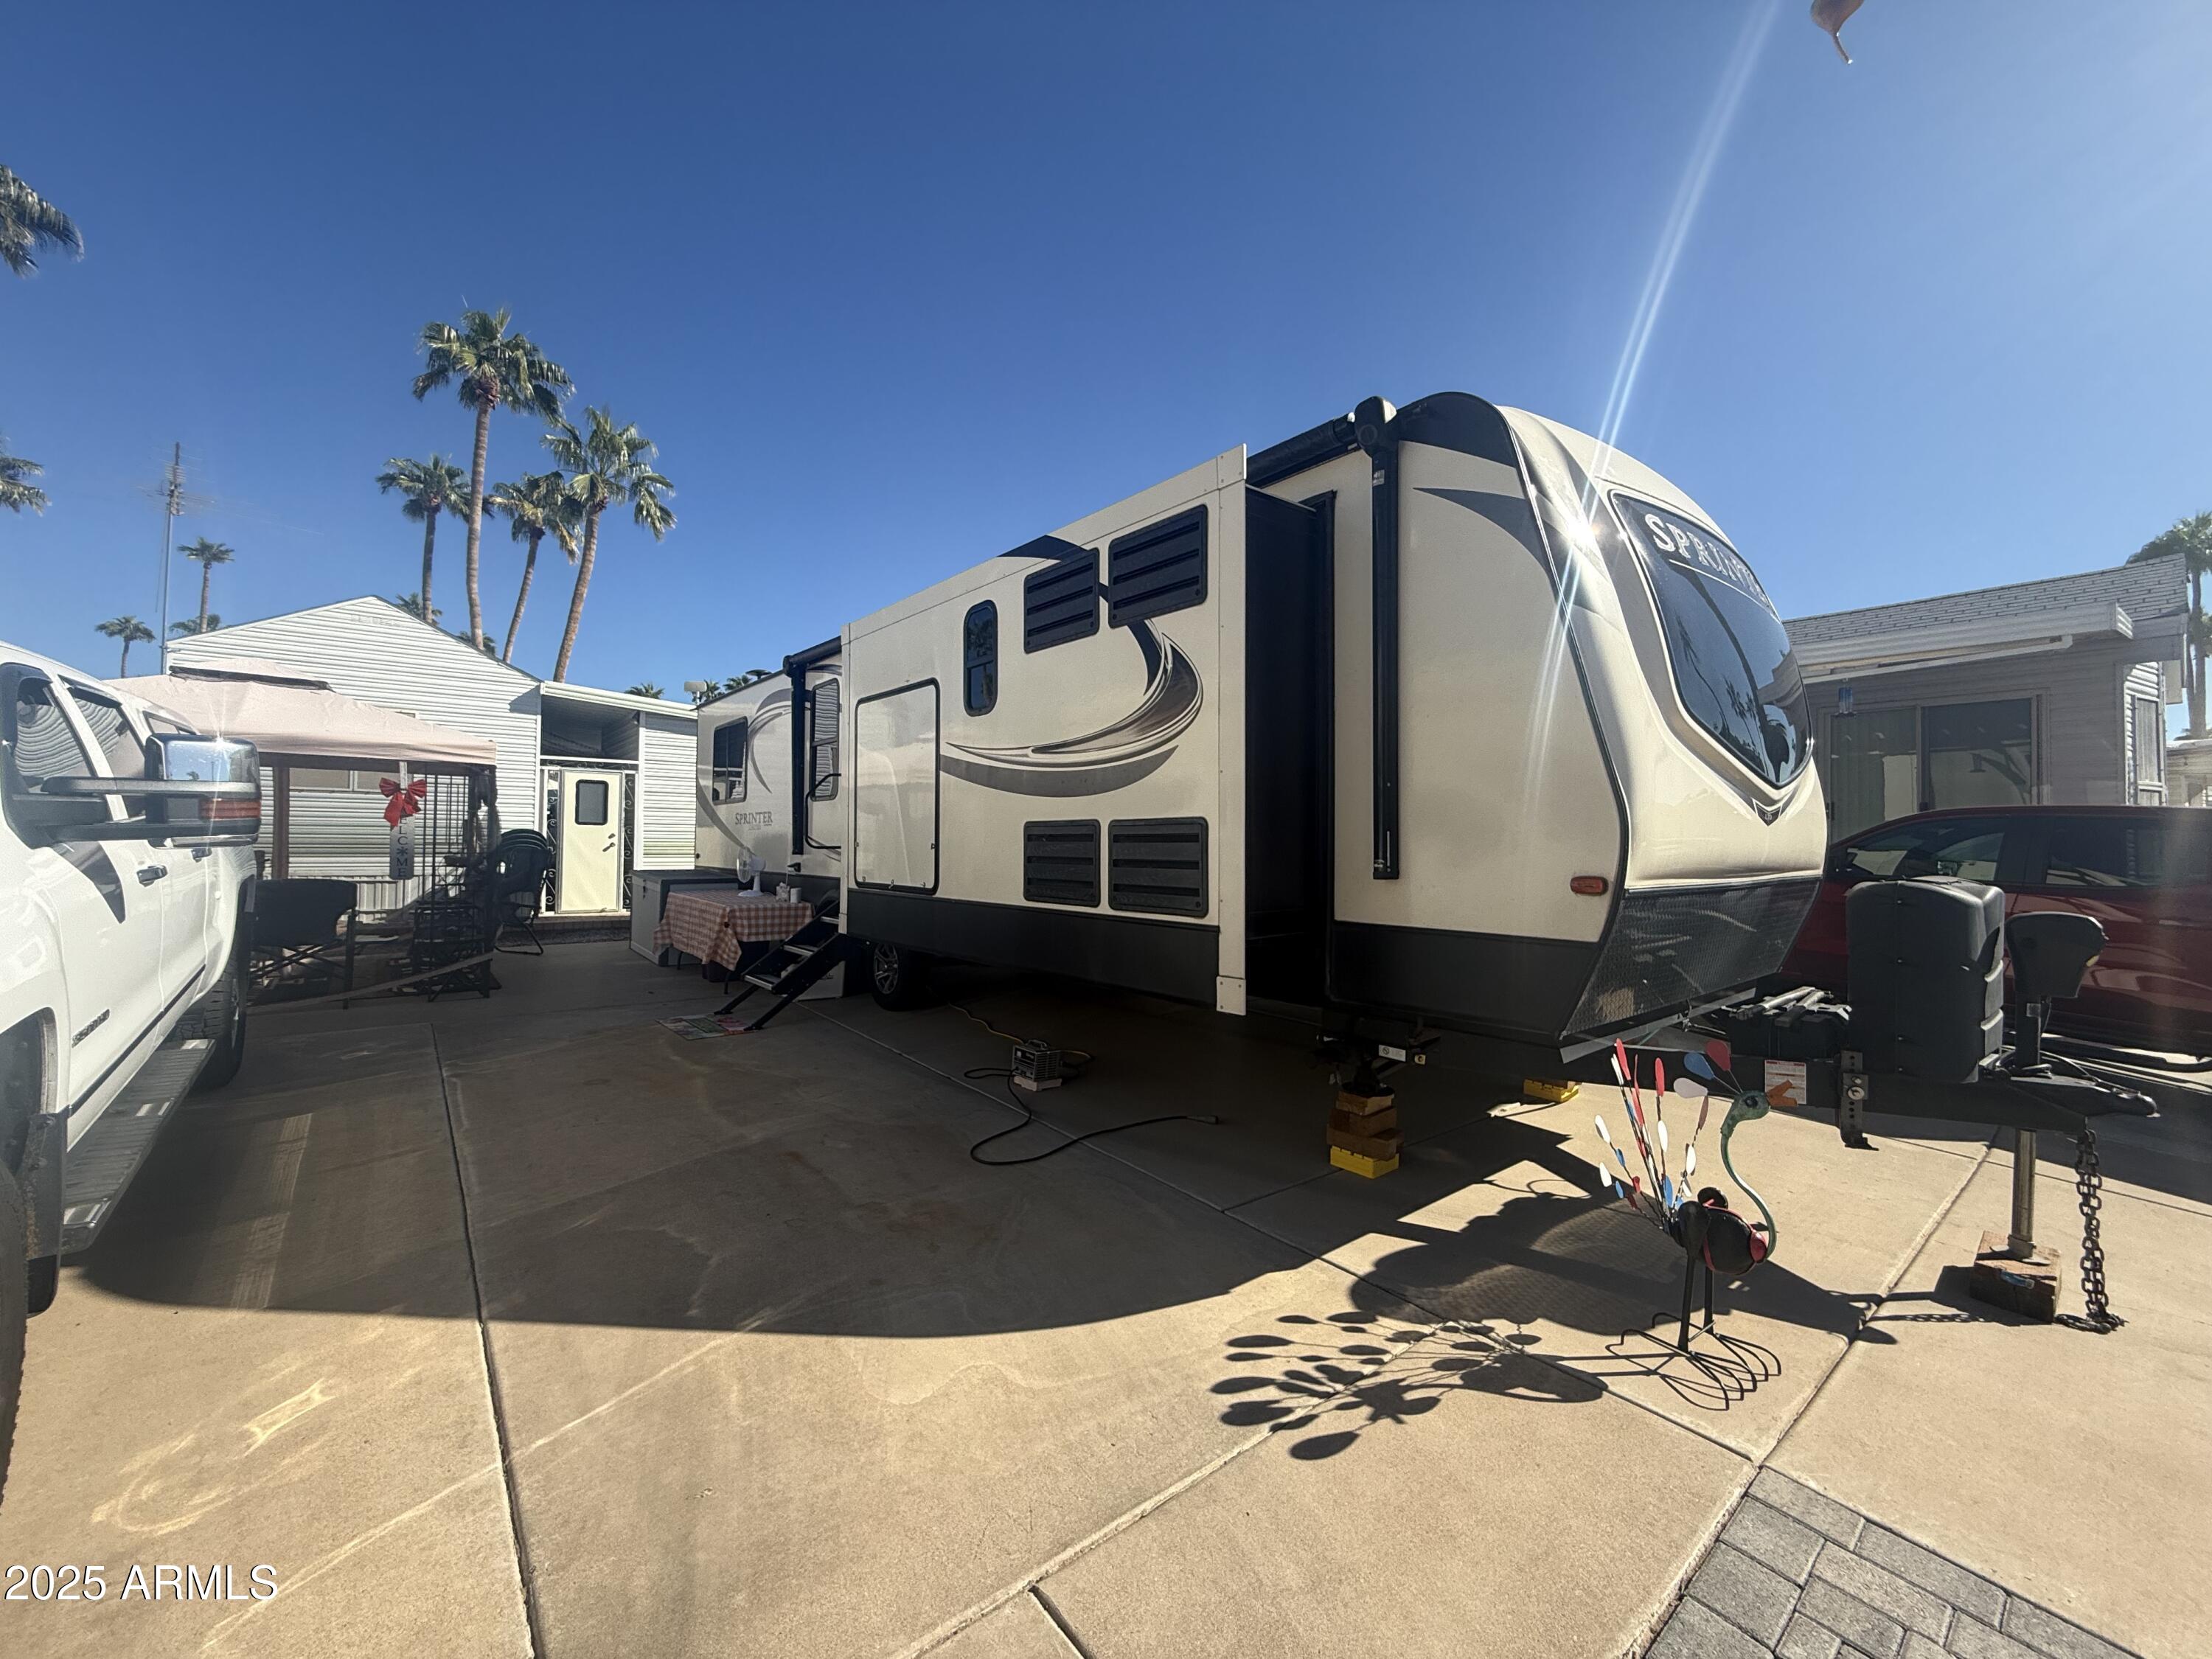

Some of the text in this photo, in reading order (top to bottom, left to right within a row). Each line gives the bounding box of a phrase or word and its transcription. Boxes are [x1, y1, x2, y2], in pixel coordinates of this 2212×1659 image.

[1645, 514, 1769, 604] SPRINT
[397, 815, 408, 877] ELCME
[735, 812, 773, 825] SPRINTER
